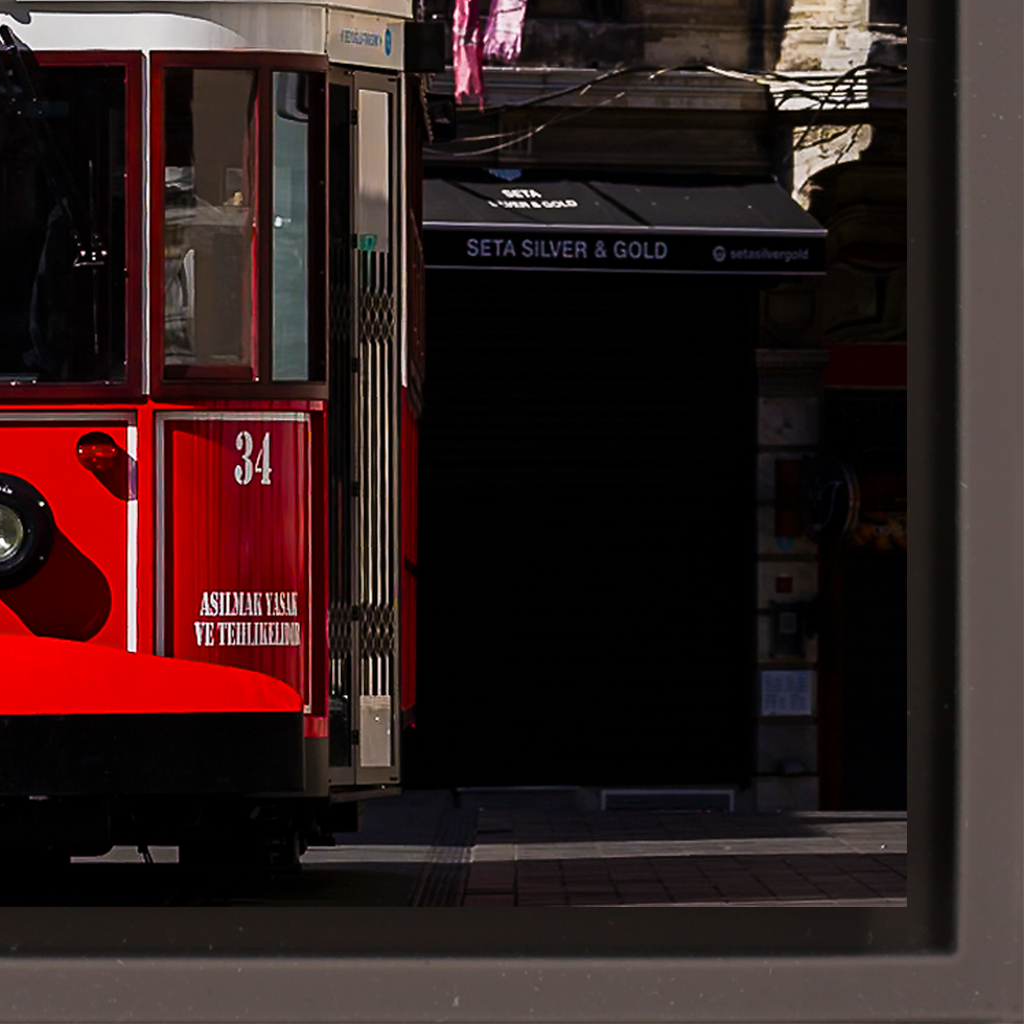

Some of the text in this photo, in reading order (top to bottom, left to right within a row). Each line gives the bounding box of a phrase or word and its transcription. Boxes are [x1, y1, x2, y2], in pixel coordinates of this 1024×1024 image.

[467, 238, 668, 260] SETA SILVER & GOLD
[234, 430, 273, 486] 34
[199, 590, 263, 617] ASILMAK
[193, 621, 215, 647] VE
